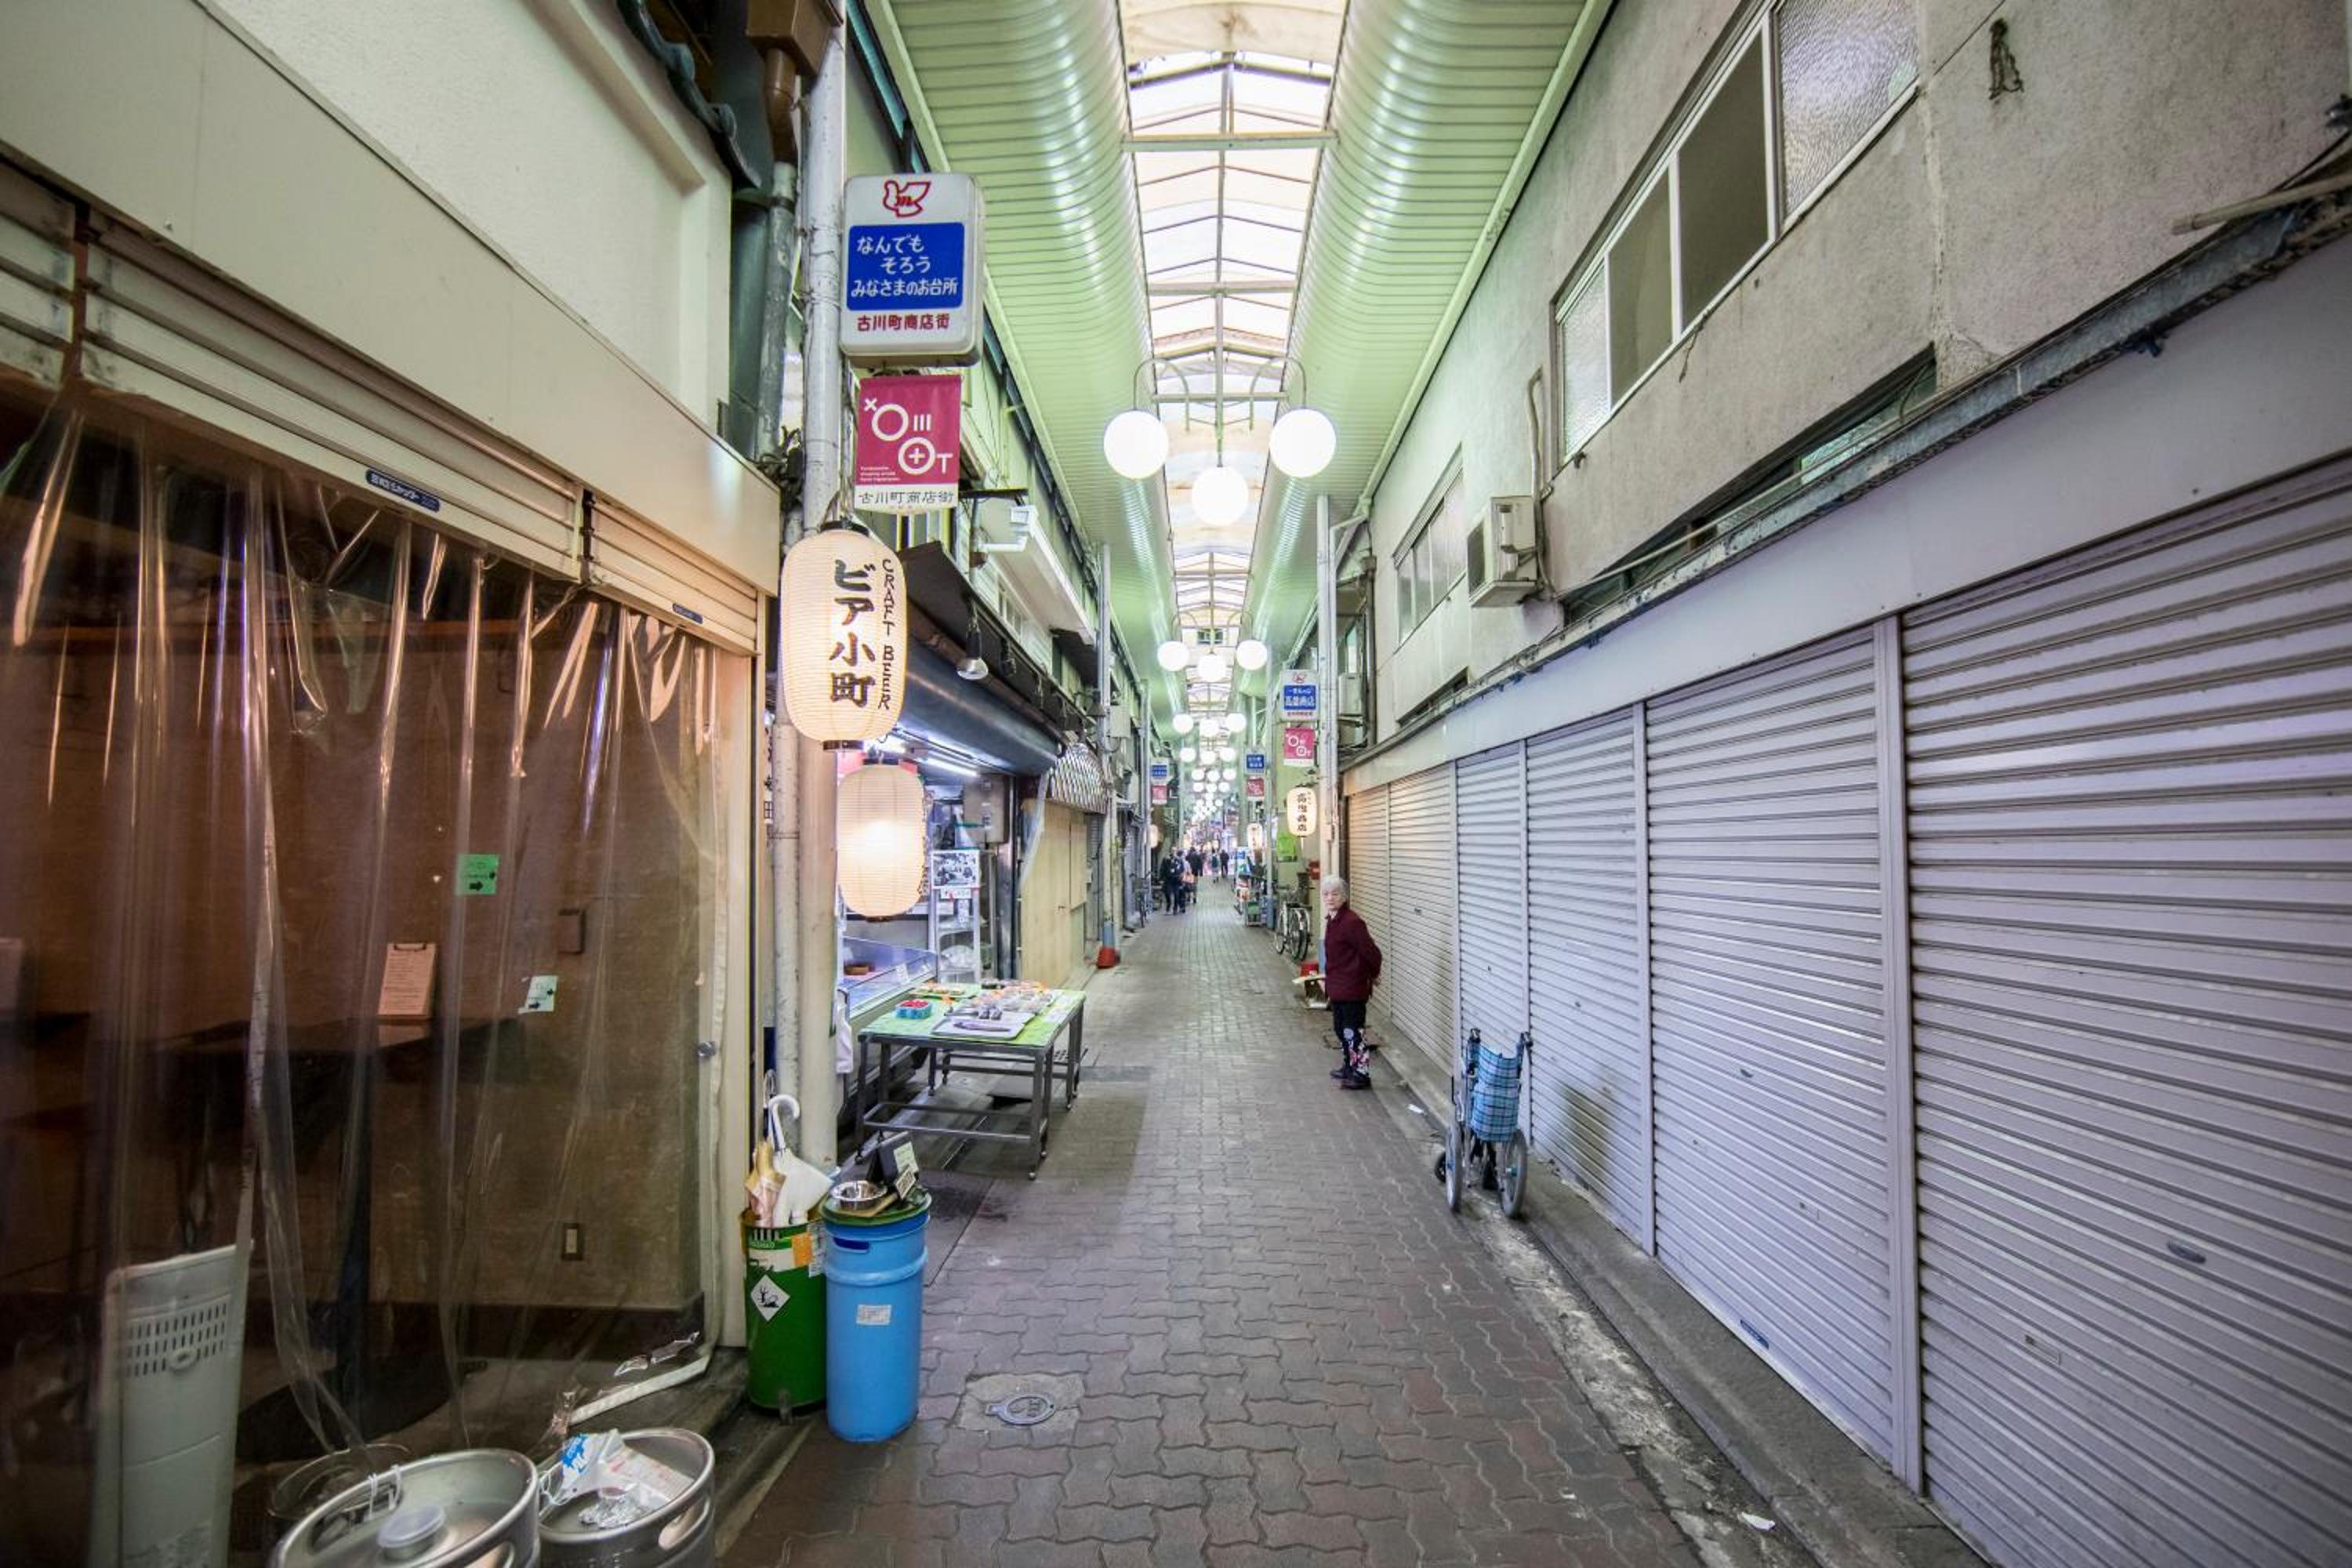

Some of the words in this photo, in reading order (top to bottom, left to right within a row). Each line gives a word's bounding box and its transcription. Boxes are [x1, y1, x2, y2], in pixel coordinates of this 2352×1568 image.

[857, 234, 924, 255] なんでも
[880, 256, 931, 274] そろう
[851, 277, 958, 298] みなさまのお台所
[857, 314, 949, 332] 古川町商店街
[858, 490, 954, 504] 古川町商店街
[882, 558, 895, 636] CRAFT
[829, 559, 877, 708] ビア小町
[878, 645, 895, 710] BEER
